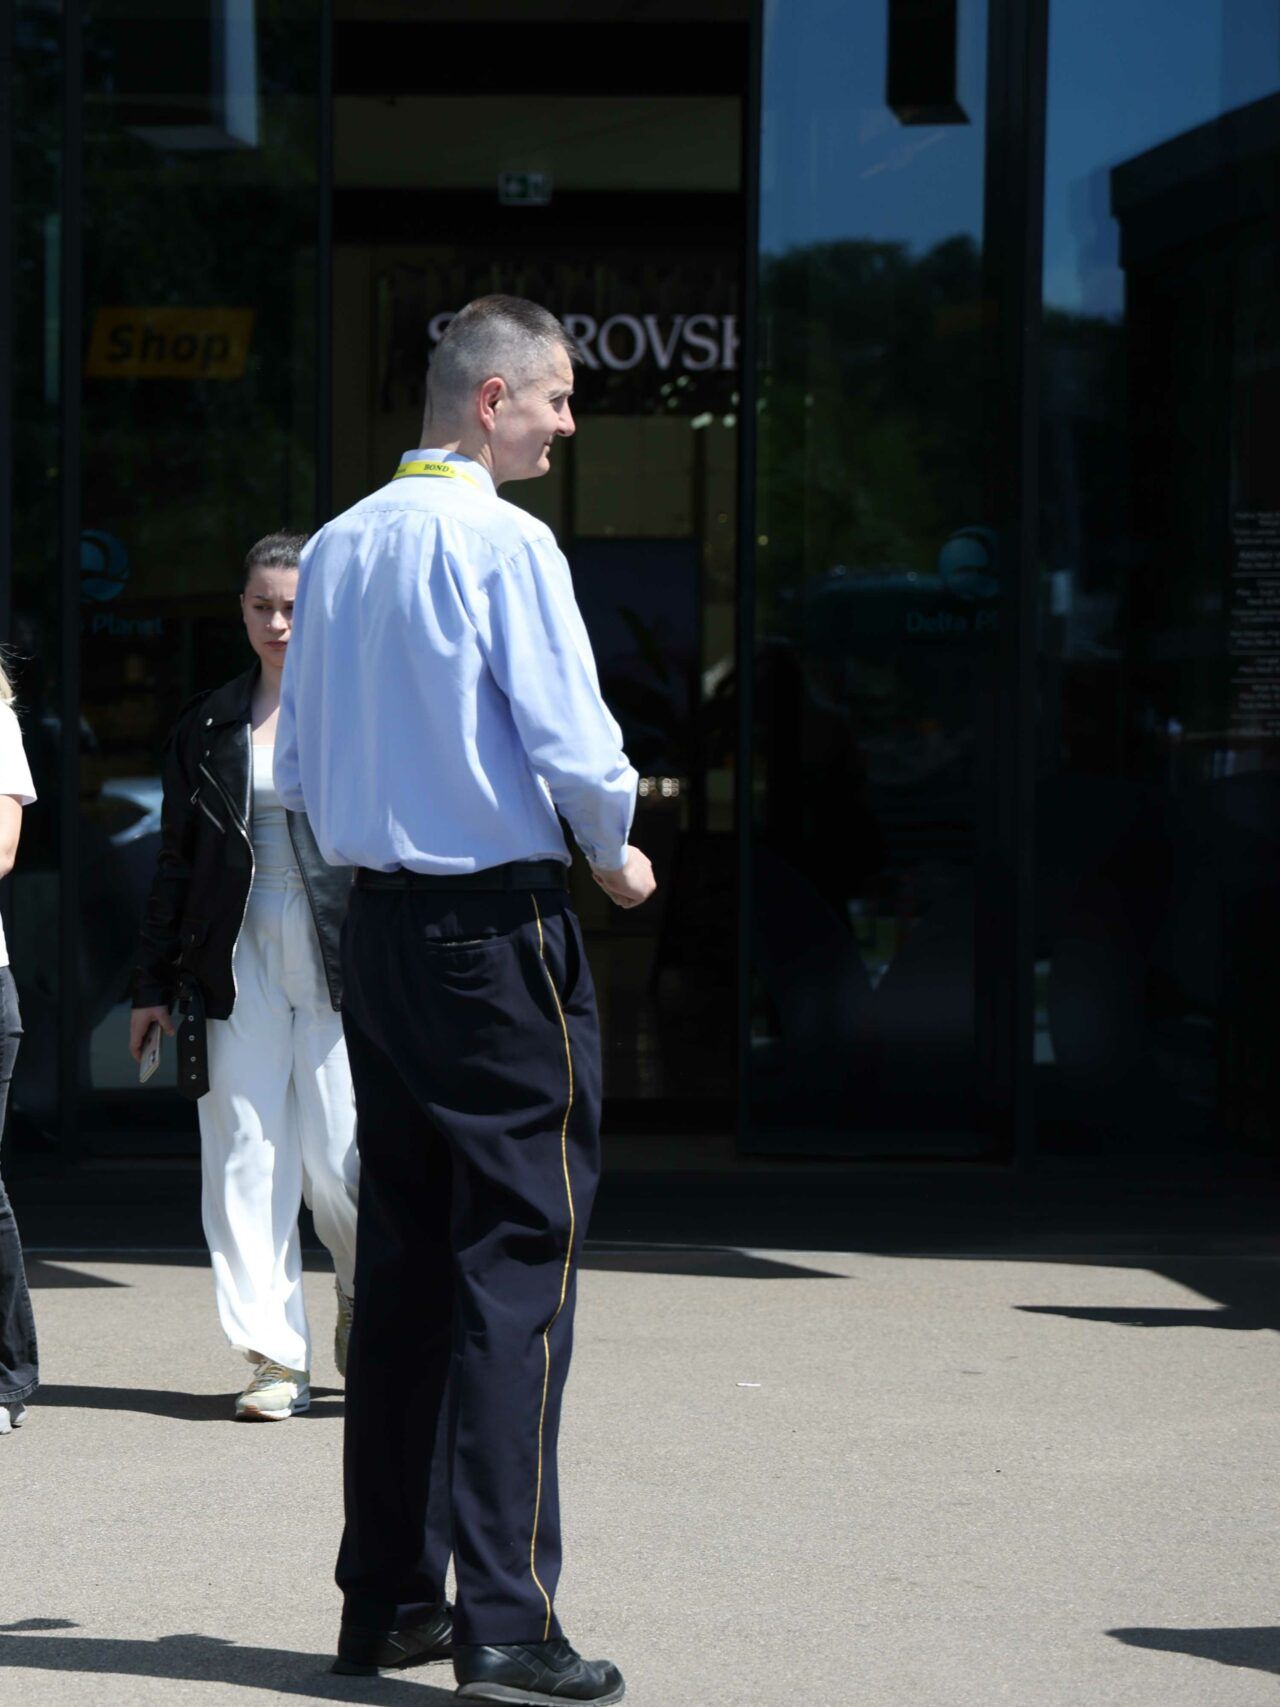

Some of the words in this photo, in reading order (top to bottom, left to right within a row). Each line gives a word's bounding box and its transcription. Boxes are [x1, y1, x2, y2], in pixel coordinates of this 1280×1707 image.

[107, 324, 228, 371] Shop
[424, 463, 449, 472] BOND
[92, 612, 165, 635] Planet
[905, 610, 968, 633] Delta
